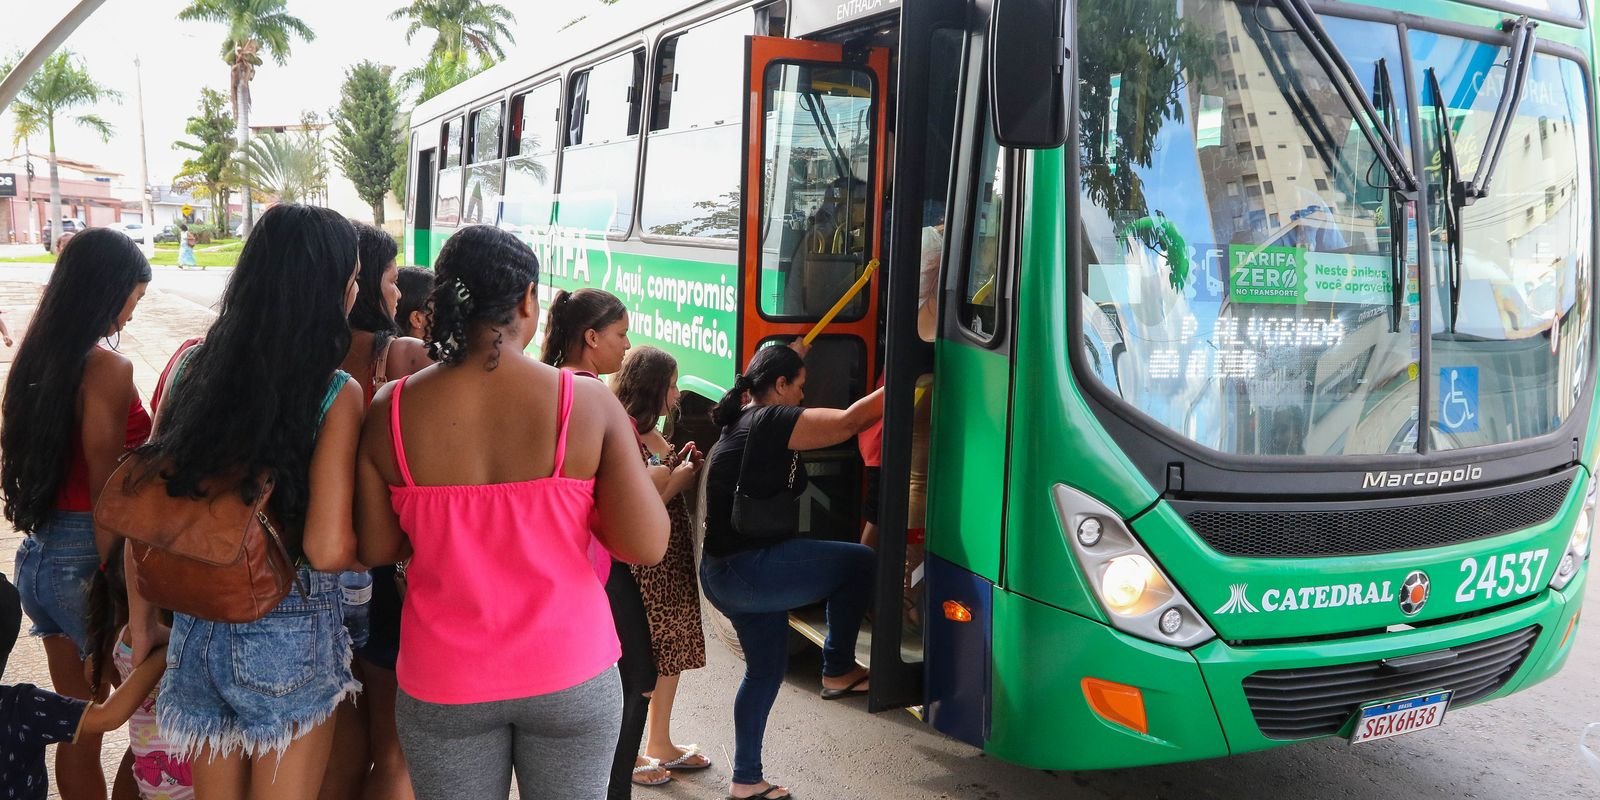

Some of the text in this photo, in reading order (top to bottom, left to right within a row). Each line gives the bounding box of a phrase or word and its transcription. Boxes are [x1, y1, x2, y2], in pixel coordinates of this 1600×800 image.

[1236, 251, 1297, 267] TARIFA
[1315, 264, 1348, 277] Neste
[615, 265, 738, 313] Aqui, compromis
[1236, 288, 1299, 297] NO TRANSPORTE
[1315, 279, 1342, 291] você
[655, 309, 733, 360] benefício.
[1181, 316, 1346, 346] P. ALVORADA
[1362, 464, 1483, 489] Marcopolo
[1455, 548, 1550, 604] 24537
[1261, 580, 1394, 612] CATEDRAL
[1362, 705, 1437, 739] SGX6H38
